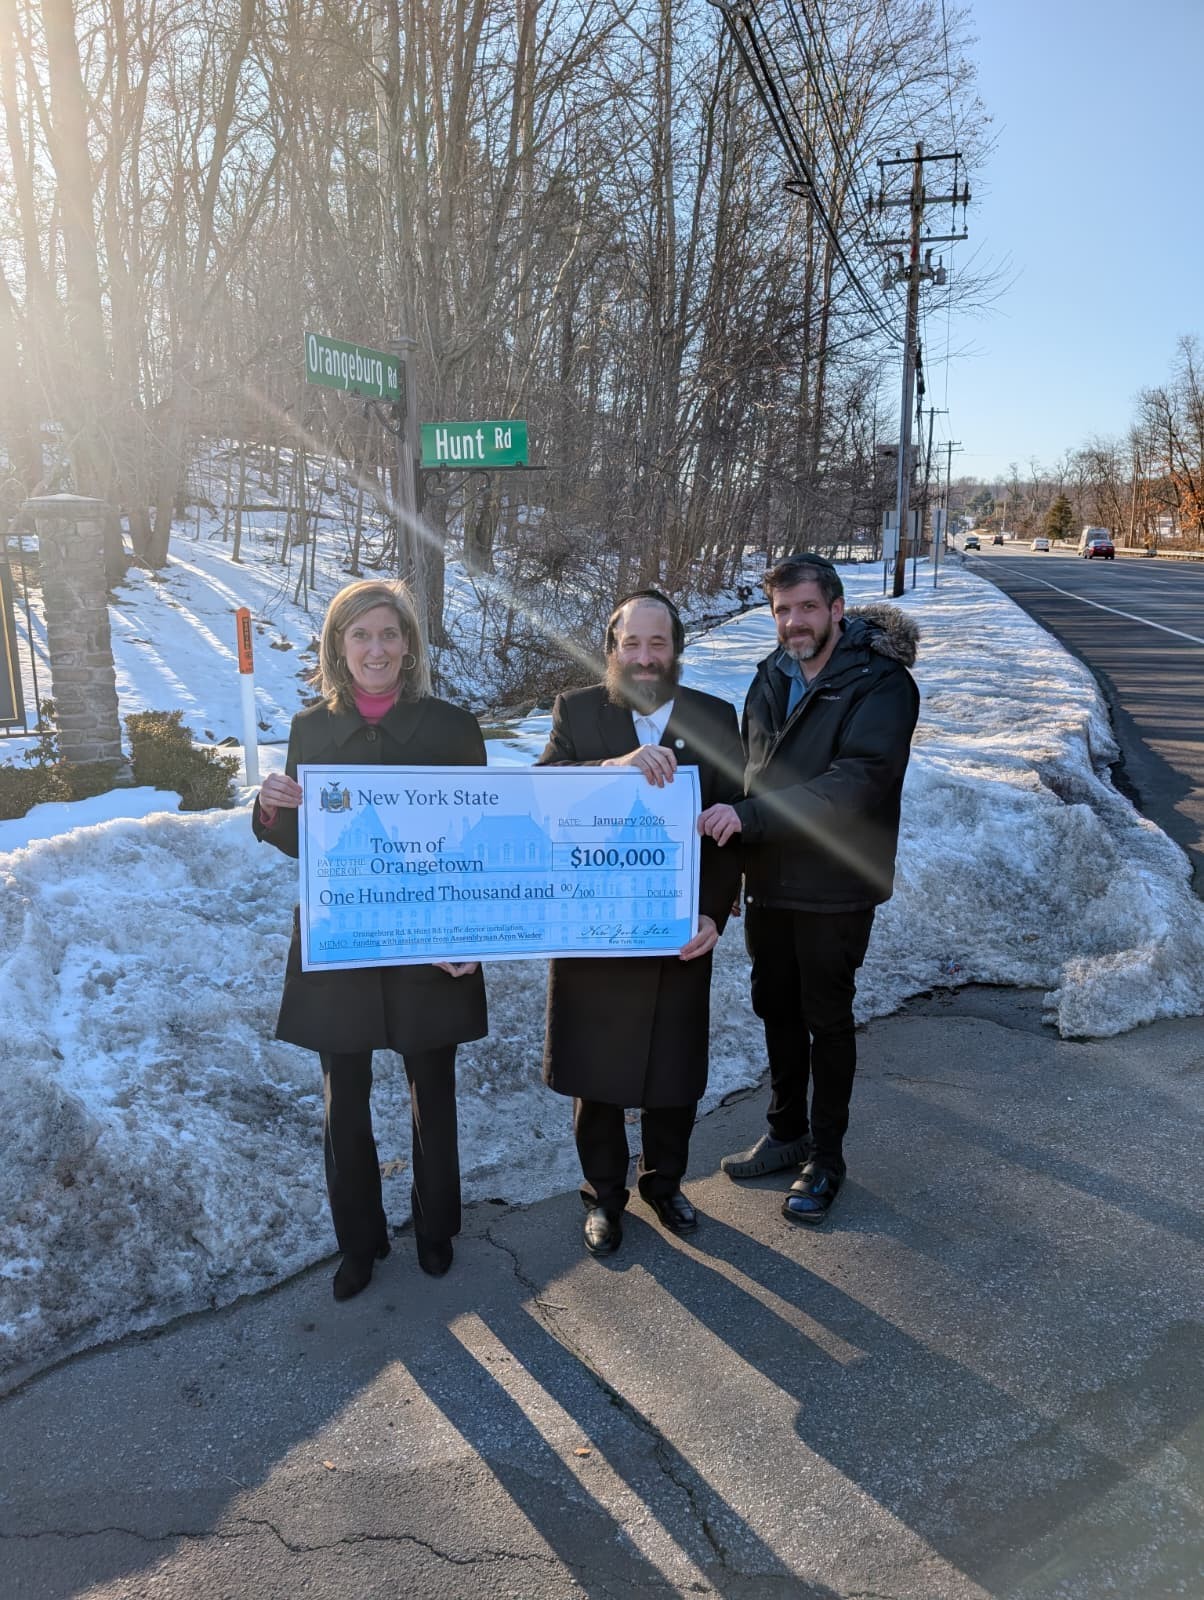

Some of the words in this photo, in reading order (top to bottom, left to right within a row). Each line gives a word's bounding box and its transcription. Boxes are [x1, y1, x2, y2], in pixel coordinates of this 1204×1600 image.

[308, 335, 383, 396] Orangeburg
[388, 365, 398, 389] Rd
[435, 428, 485, 460] Hunt
[495, 427, 512, 449] Rd
[358, 790, 400, 806] New
[404, 789, 450, 806] York
[454, 789, 499, 806] State
[593, 815, 638, 828] January
[639, 816, 666, 826] 2026
[370, 838, 422, 854] Town
[426, 836, 446, 854] of
[370, 857, 484, 876] Orangetown
[570, 846, 666, 869] $100,000
[319, 890, 355, 905] One
[359, 886, 435, 904] Hundred
[438, 884, 523, 902] Thousand
[525, 883, 554, 899] and
